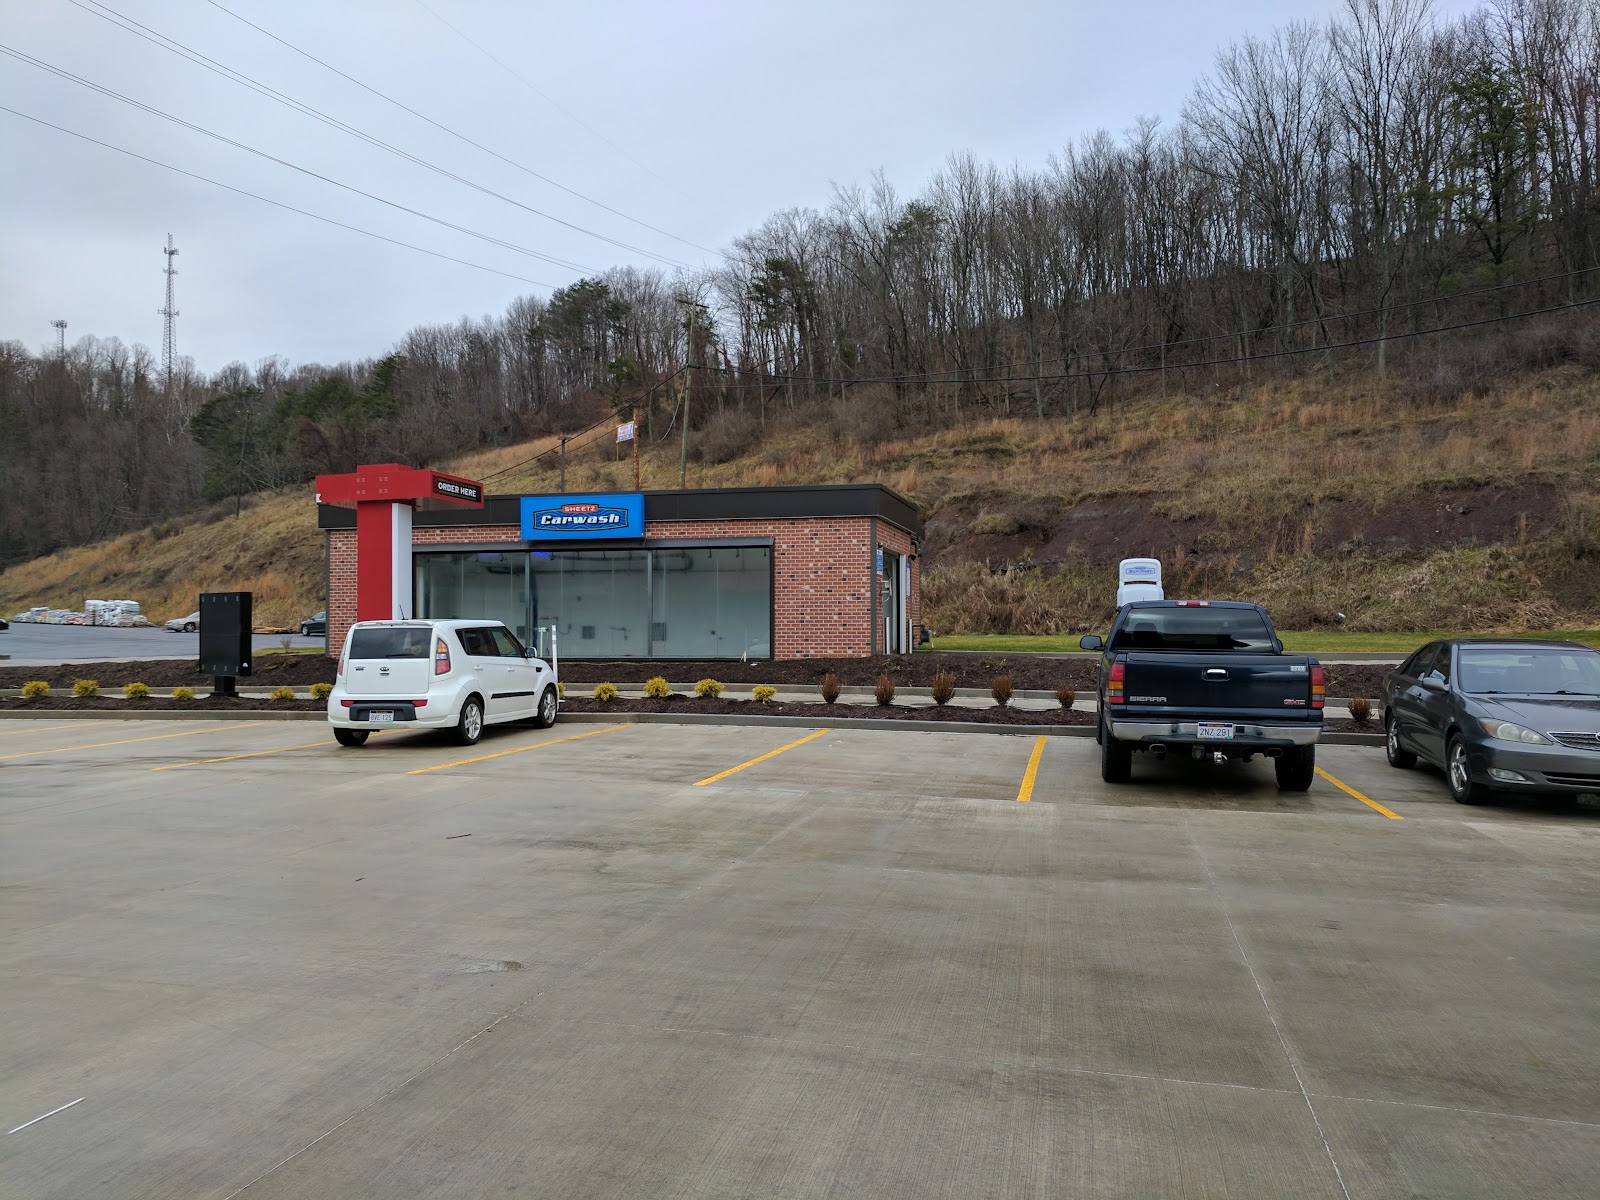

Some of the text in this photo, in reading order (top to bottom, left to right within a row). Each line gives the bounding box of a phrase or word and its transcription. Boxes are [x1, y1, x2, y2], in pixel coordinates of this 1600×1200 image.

[437, 481, 477, 498] ORDER HERE
[540, 513, 620, 525] Carwash
[1129, 695, 1168, 703] SIERRA
